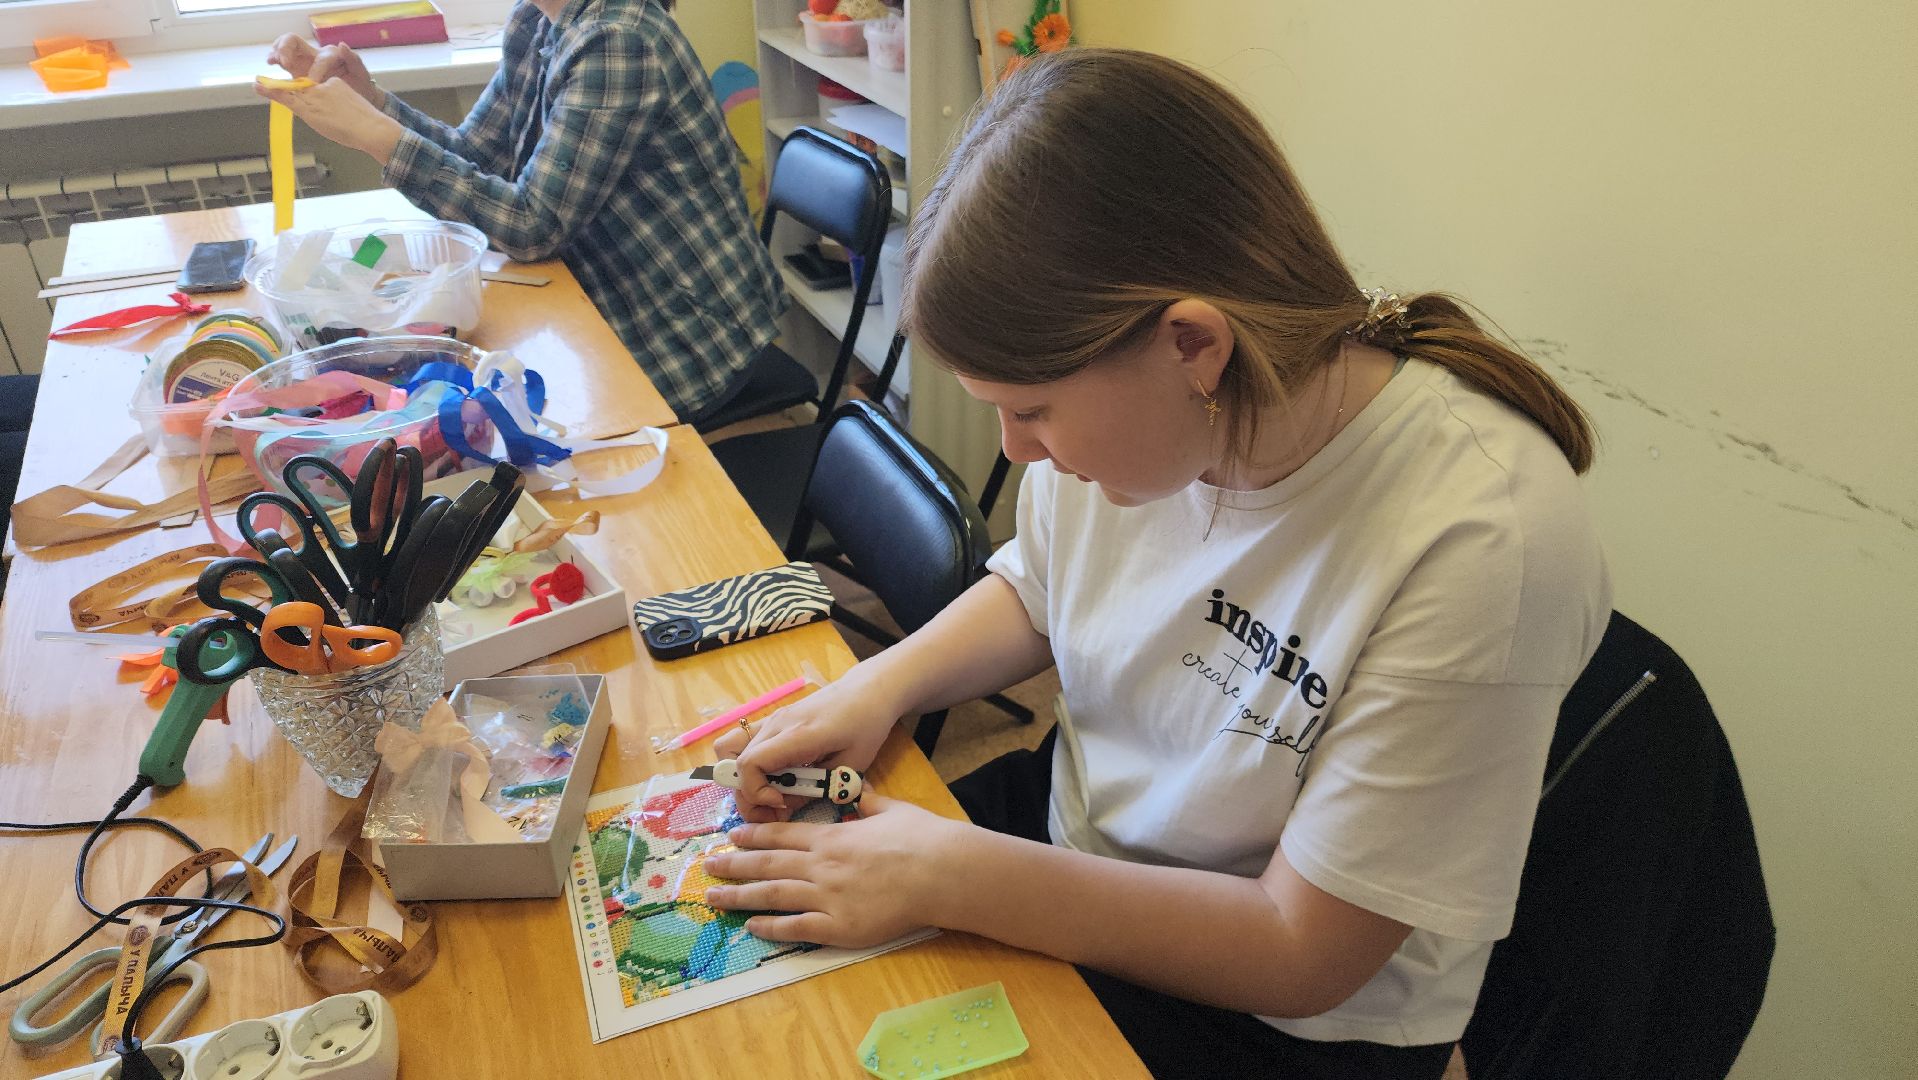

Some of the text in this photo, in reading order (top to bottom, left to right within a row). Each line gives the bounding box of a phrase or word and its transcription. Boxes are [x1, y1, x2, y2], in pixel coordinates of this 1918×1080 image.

[1182, 649, 1253, 698] create
[1204, 588, 1328, 709] inspire
[116, 959, 139, 1016] ПАЛЫЧА
